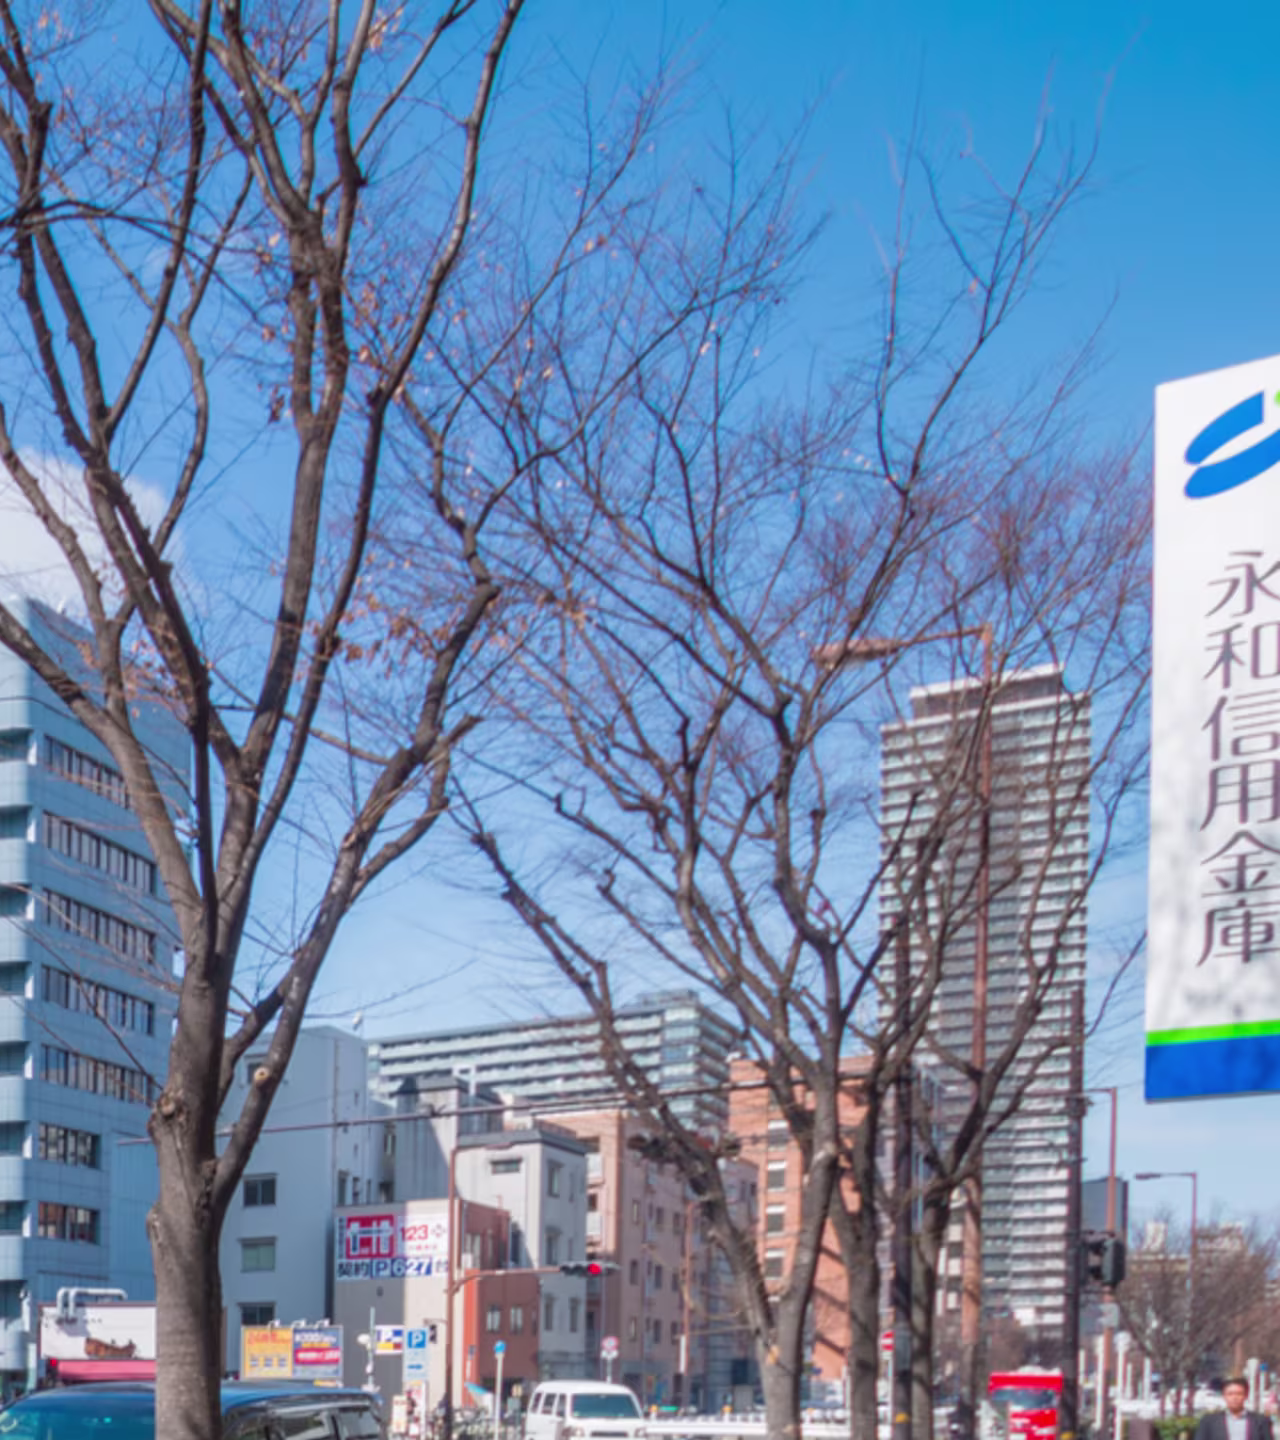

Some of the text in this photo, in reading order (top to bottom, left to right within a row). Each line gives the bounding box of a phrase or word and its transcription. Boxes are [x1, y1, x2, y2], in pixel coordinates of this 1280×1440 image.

[1196, 550, 1280, 970] 永和信用金庫
